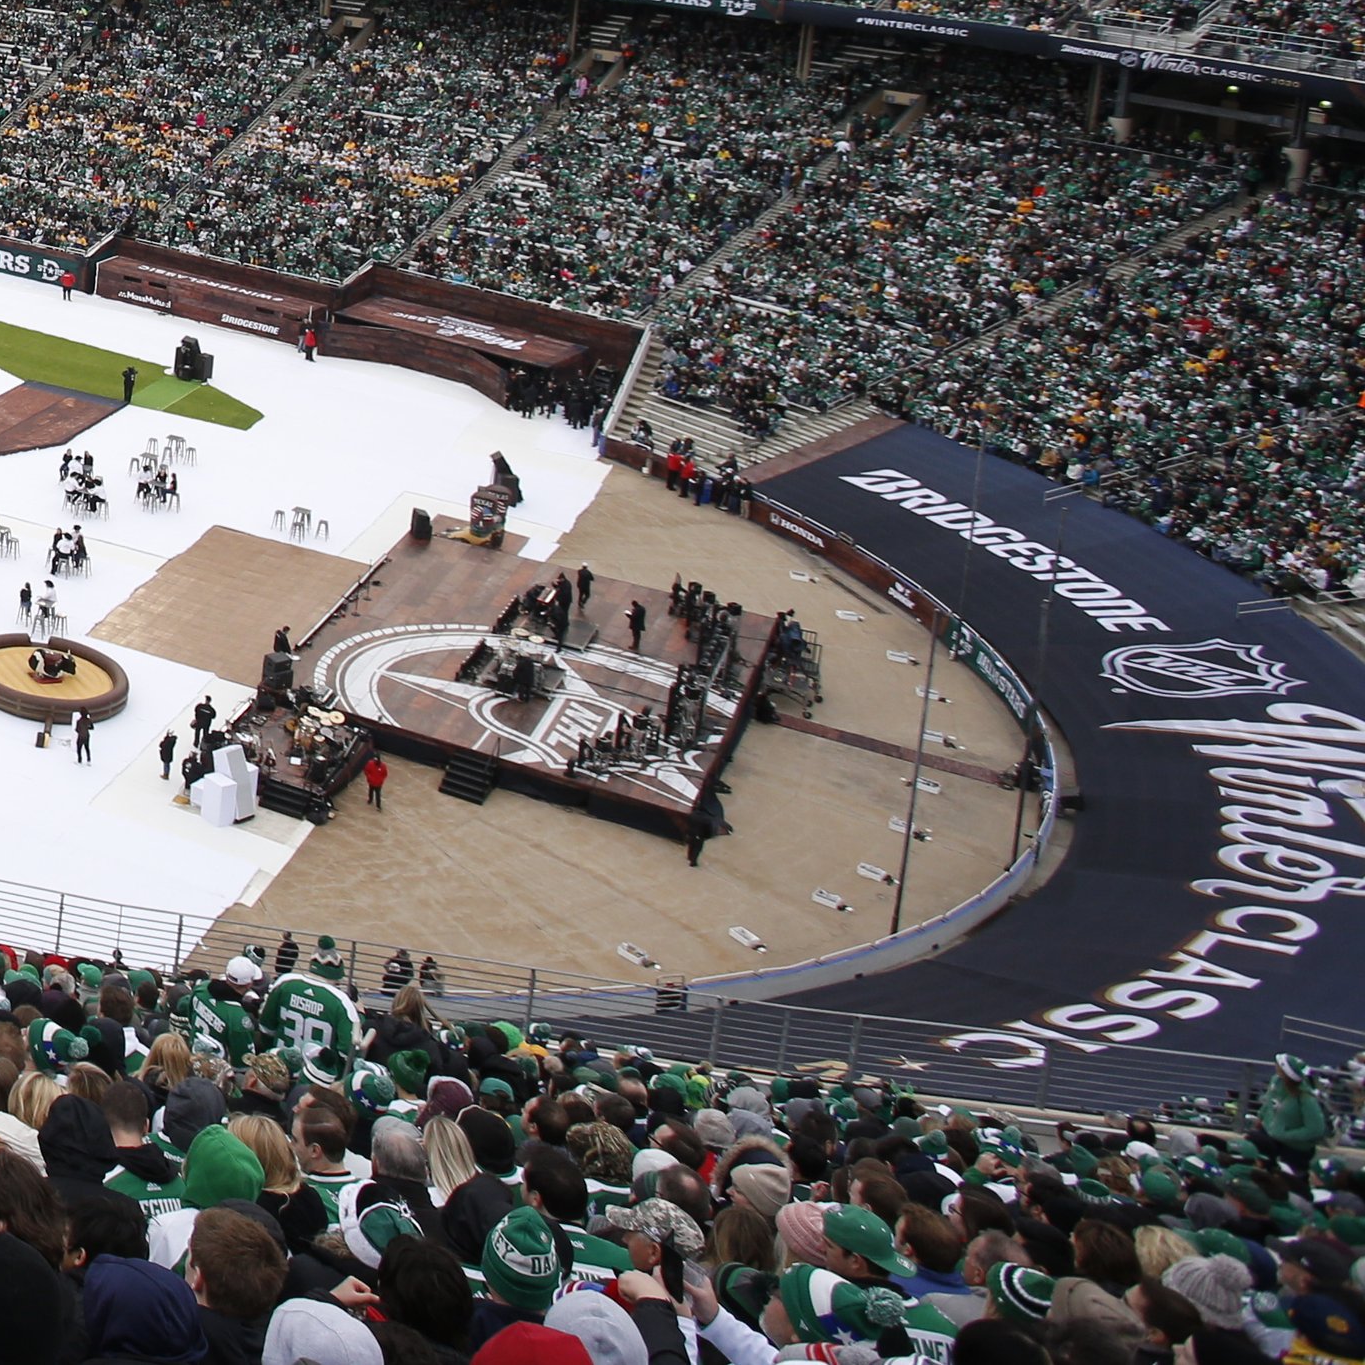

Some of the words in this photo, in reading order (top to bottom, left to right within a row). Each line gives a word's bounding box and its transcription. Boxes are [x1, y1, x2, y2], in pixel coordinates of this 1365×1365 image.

[855, 16, 969, 37] #WINTERCLASSIC
[1139, 50, 1201, 76] Winter
[1200, 65, 1263, 84] CLASSIC
[137, 264, 285, 303] #WINTERCLASSIC
[126, 289, 172, 310] MassMutual
[220, 313, 280, 335] BRIDGESTONE
[473, 497, 494, 509] TEXAS
[780, 518, 826, 549] HONDA
[838, 468, 1172, 633] BRIDGESTONE
[1140, 655, 1254, 687] NHL
[546, 700, 605, 754] NHL
[1099, 701, 1365, 904] Winter
[939, 904, 1321, 1070] CLASSIC
[290, 993, 325, 1016] BISHOP
[138, 1197, 182, 1218] EGUIN
